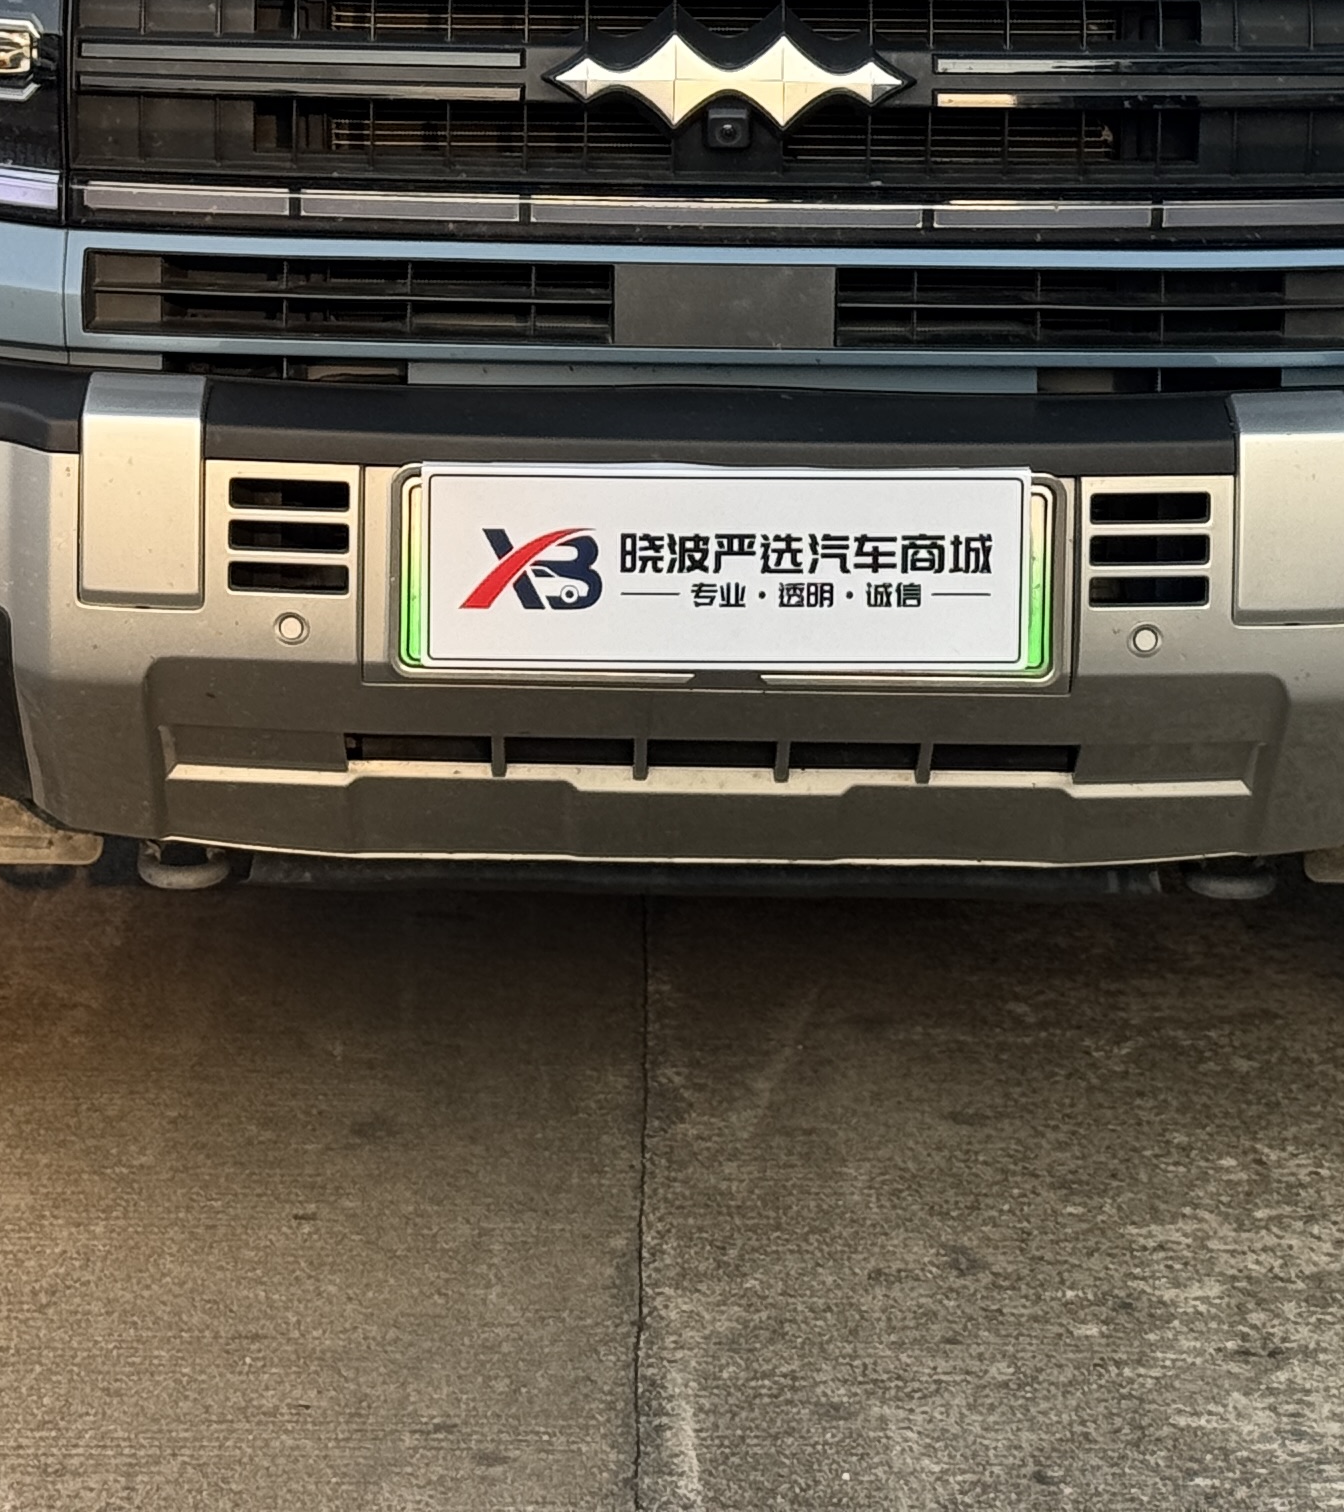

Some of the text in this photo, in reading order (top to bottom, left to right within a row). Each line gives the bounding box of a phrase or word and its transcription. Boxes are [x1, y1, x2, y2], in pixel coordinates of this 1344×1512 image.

[619, 532, 993, 575] 晓波严选汽车商城
